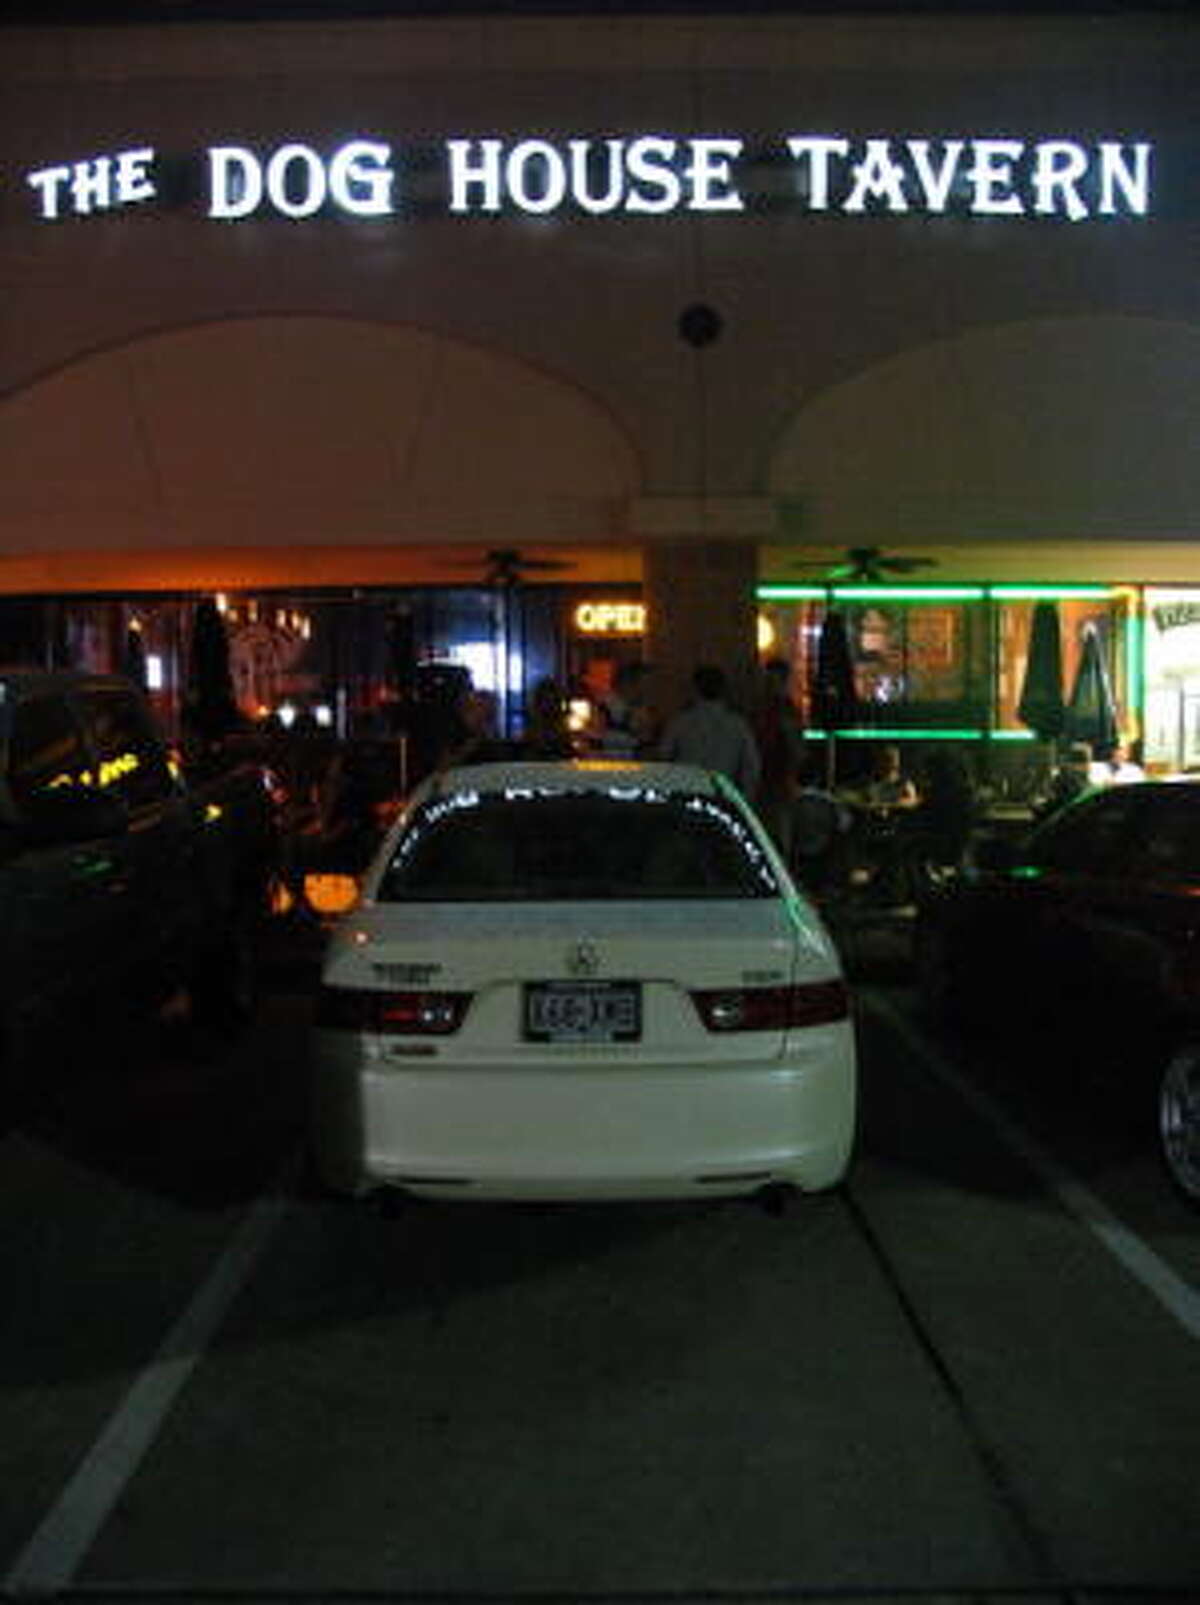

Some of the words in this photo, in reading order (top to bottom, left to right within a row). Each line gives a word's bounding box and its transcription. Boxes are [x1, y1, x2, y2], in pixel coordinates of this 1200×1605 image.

[28, 148, 156, 217] THE
[207, 141, 394, 217] DOG
[447, 136, 744, 214] HOUSE
[786, 137, 1152, 221] TAVERN
